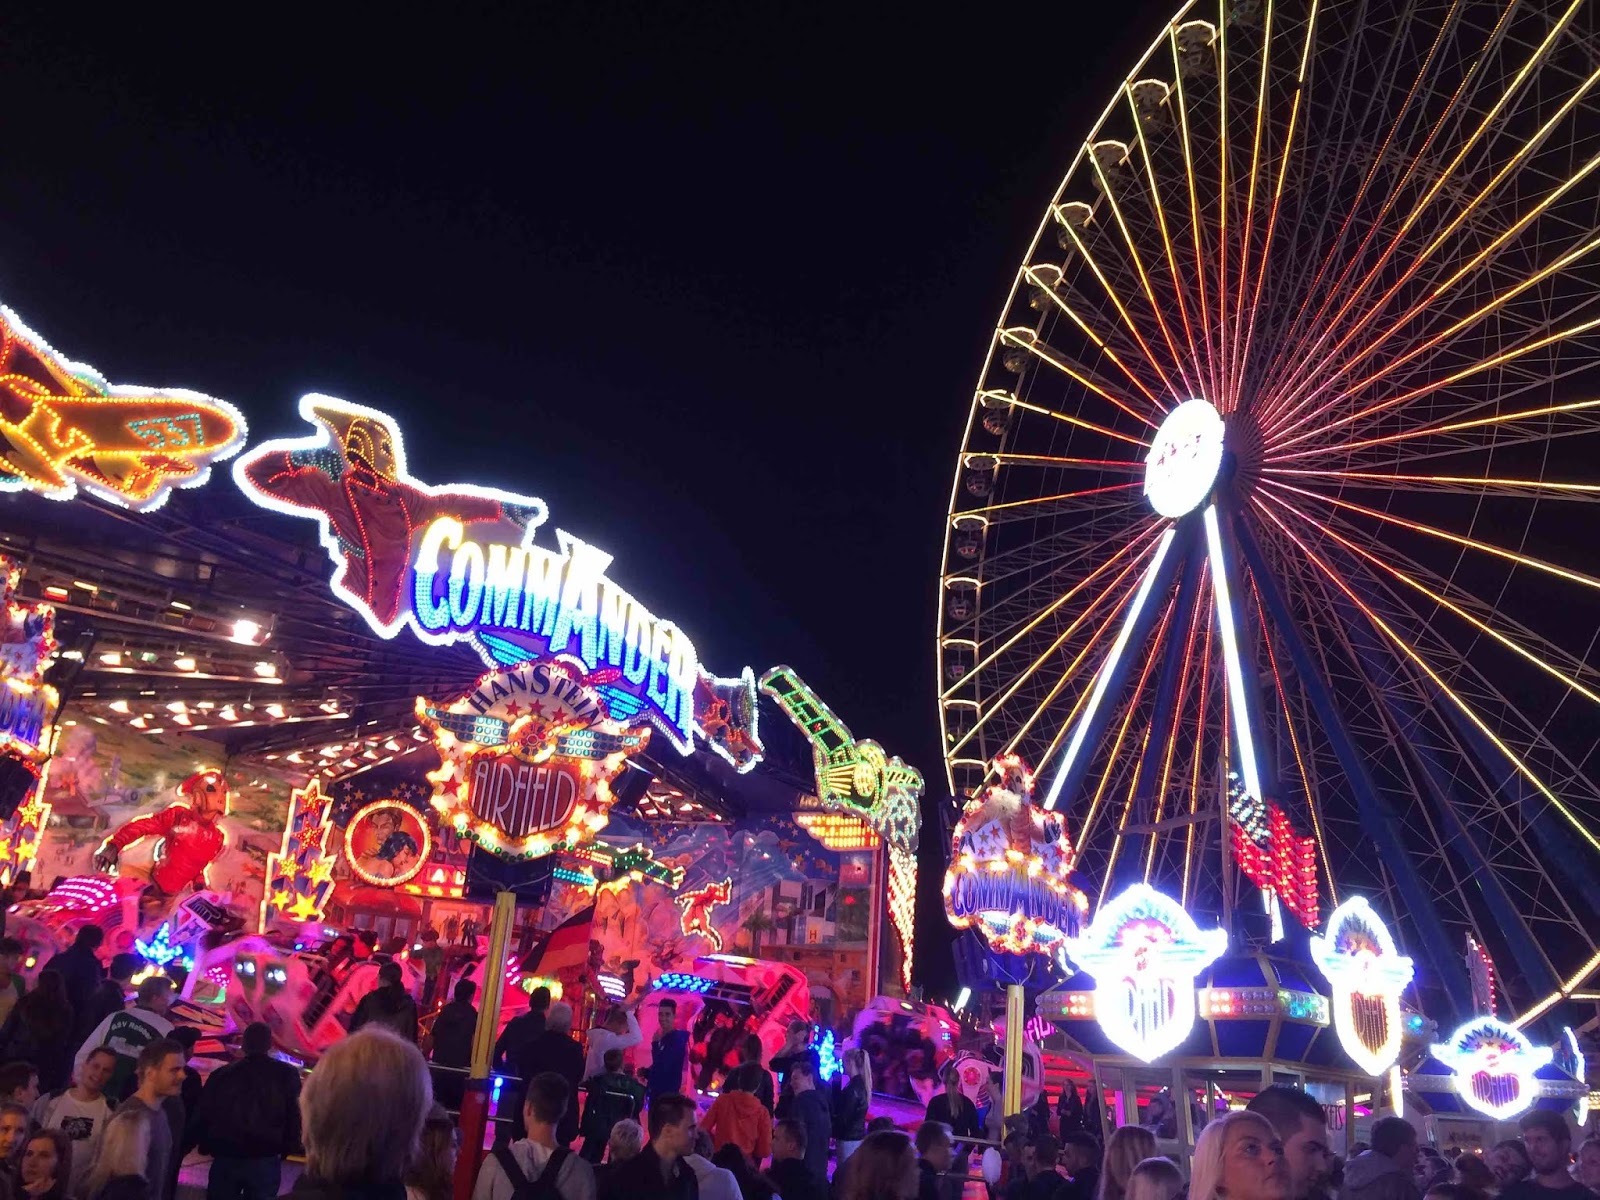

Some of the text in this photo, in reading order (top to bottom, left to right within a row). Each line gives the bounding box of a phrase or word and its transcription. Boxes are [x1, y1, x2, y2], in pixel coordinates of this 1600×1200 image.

[128, 413, 205, 449] 537
[471, 759, 578, 837] AIRFIELD
[951, 865, 1080, 939] COMMANDER
